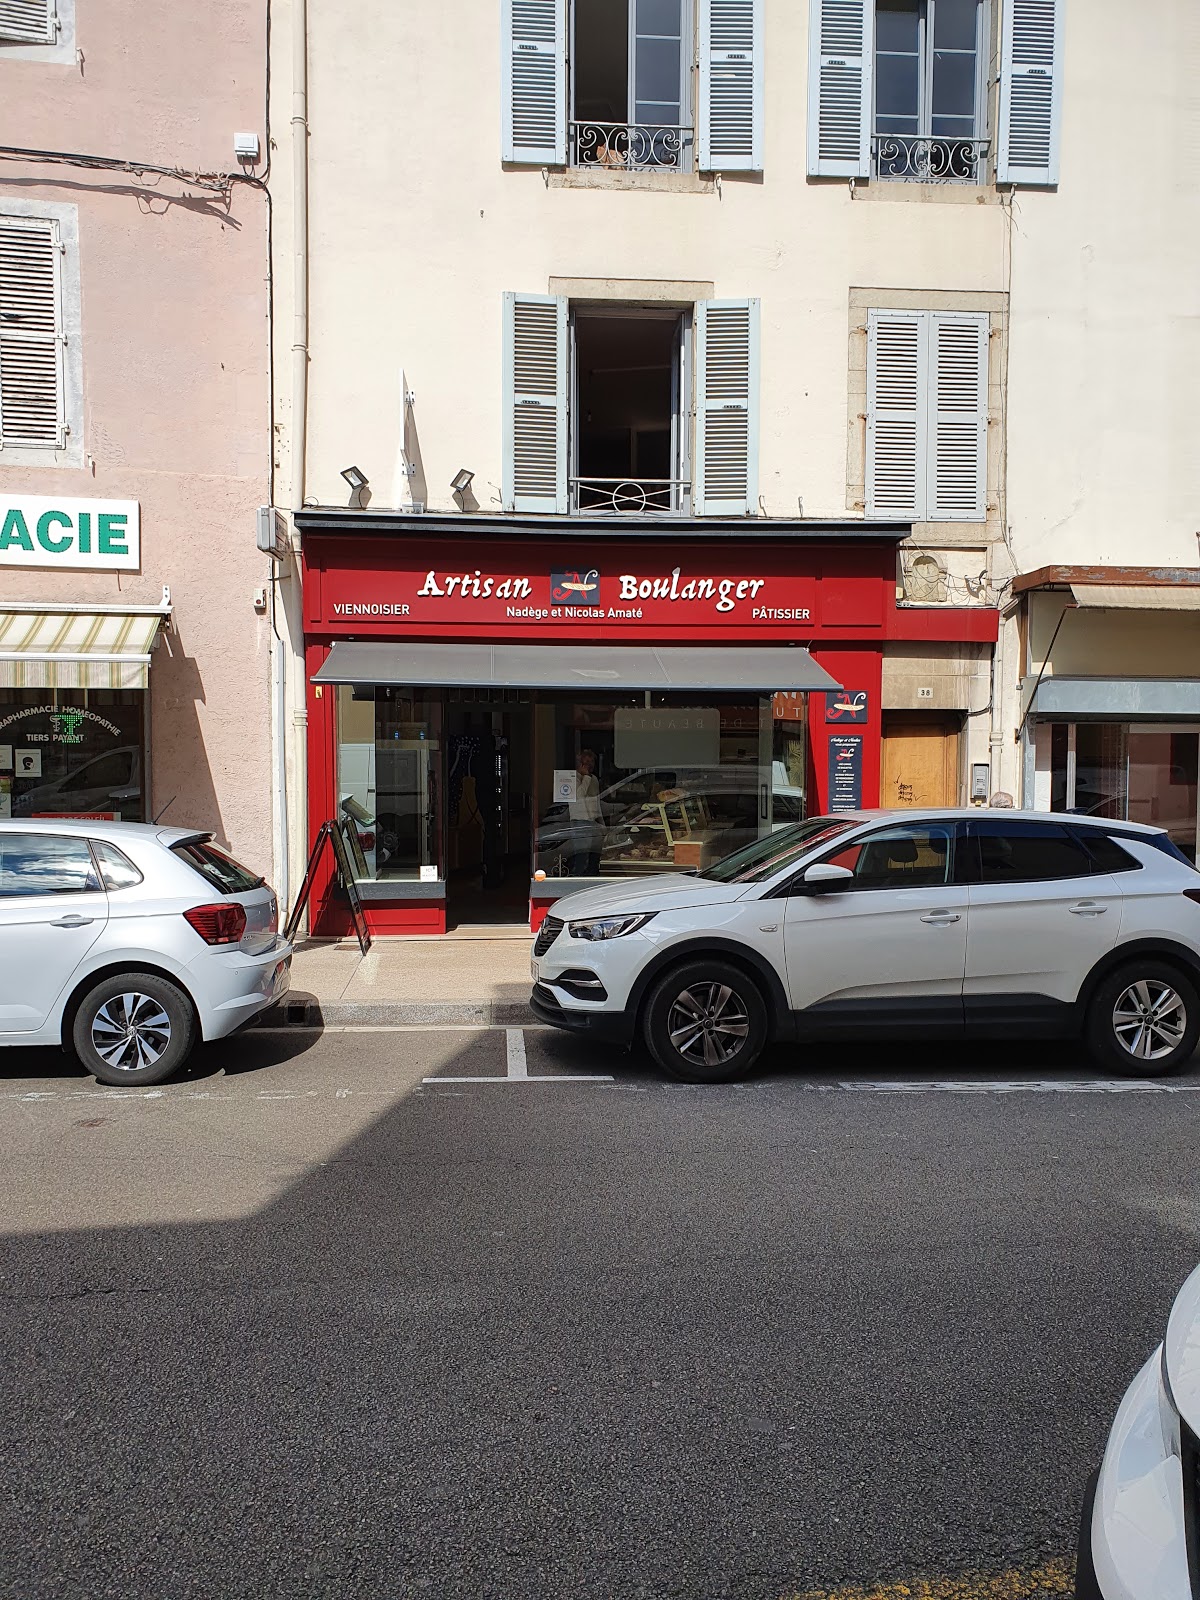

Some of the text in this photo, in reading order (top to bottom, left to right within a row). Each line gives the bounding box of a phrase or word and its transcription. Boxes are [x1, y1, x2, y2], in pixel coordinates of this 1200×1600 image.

[0, 509, 129, 554] ACIE
[417, 570, 532, 599] Artisan
[619, 567, 765, 612] Boulanger
[333, 603, 410, 616] VIENNOISIER
[506, 606, 643, 620] Nadège et Nicolas Amaté
[752, 606, 810, 620] PÂTISSIER
[26, 734, 84, 742] TIERS PAYANT
